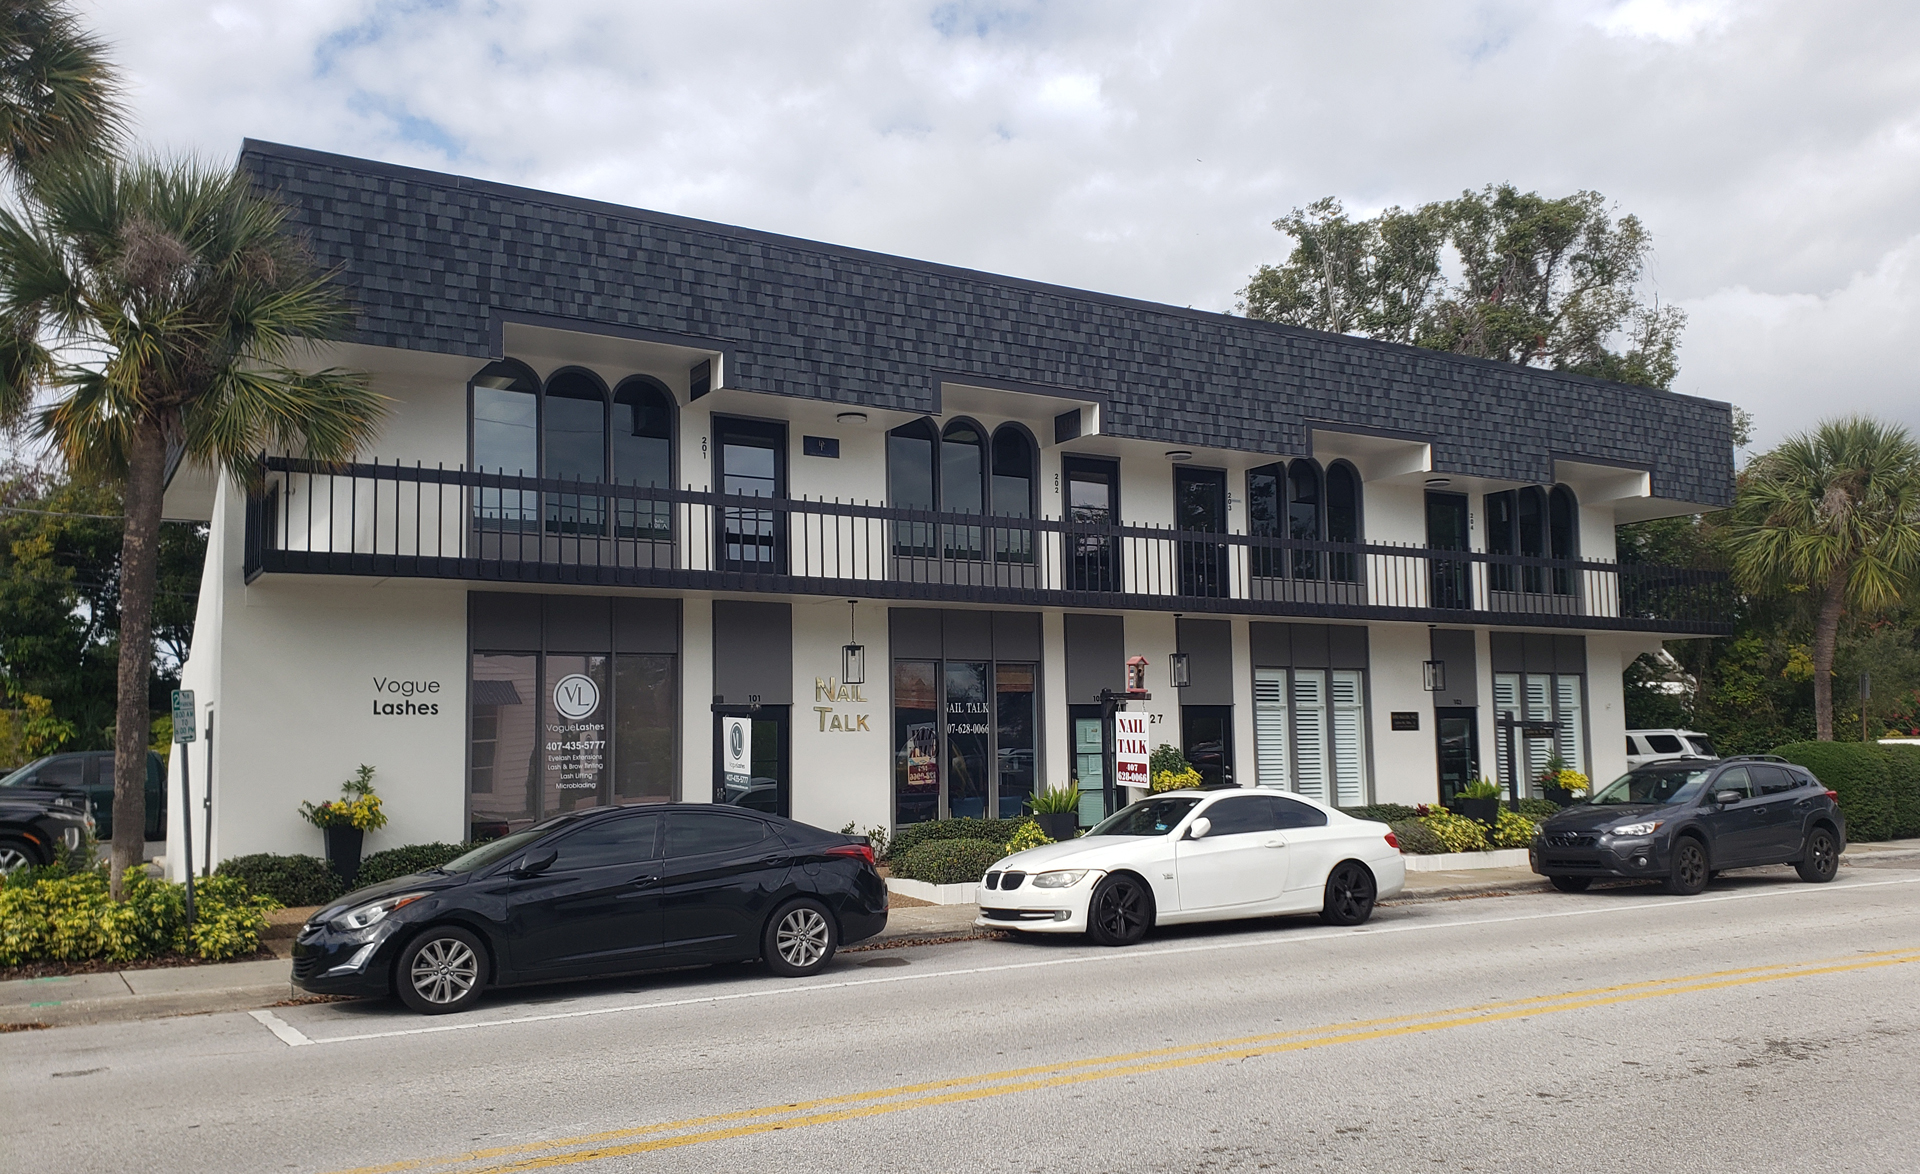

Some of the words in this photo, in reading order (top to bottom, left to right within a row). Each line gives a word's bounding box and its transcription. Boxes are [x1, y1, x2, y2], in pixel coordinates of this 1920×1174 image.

[373, 676, 440, 697] Vogue
[815, 676, 868, 702] NAIL
[173, 694, 180, 708] 2
[564, 683, 590, 706] VL
[373, 699, 439, 715] Lashes
[966, 702, 989, 713] TALK
[813, 706, 870, 732] TALK
[1118, 718, 1146, 734] NAIL
[546, 722, 605, 734] VogueLashes
[545, 741, 606, 751] 407-435-5777
[1117, 738, 1147, 754] TALK
[1126, 763, 1138, 772] 407
[1118, 771, 1147, 783] 628-0066
[555, 782, 597, 790] Microblading
